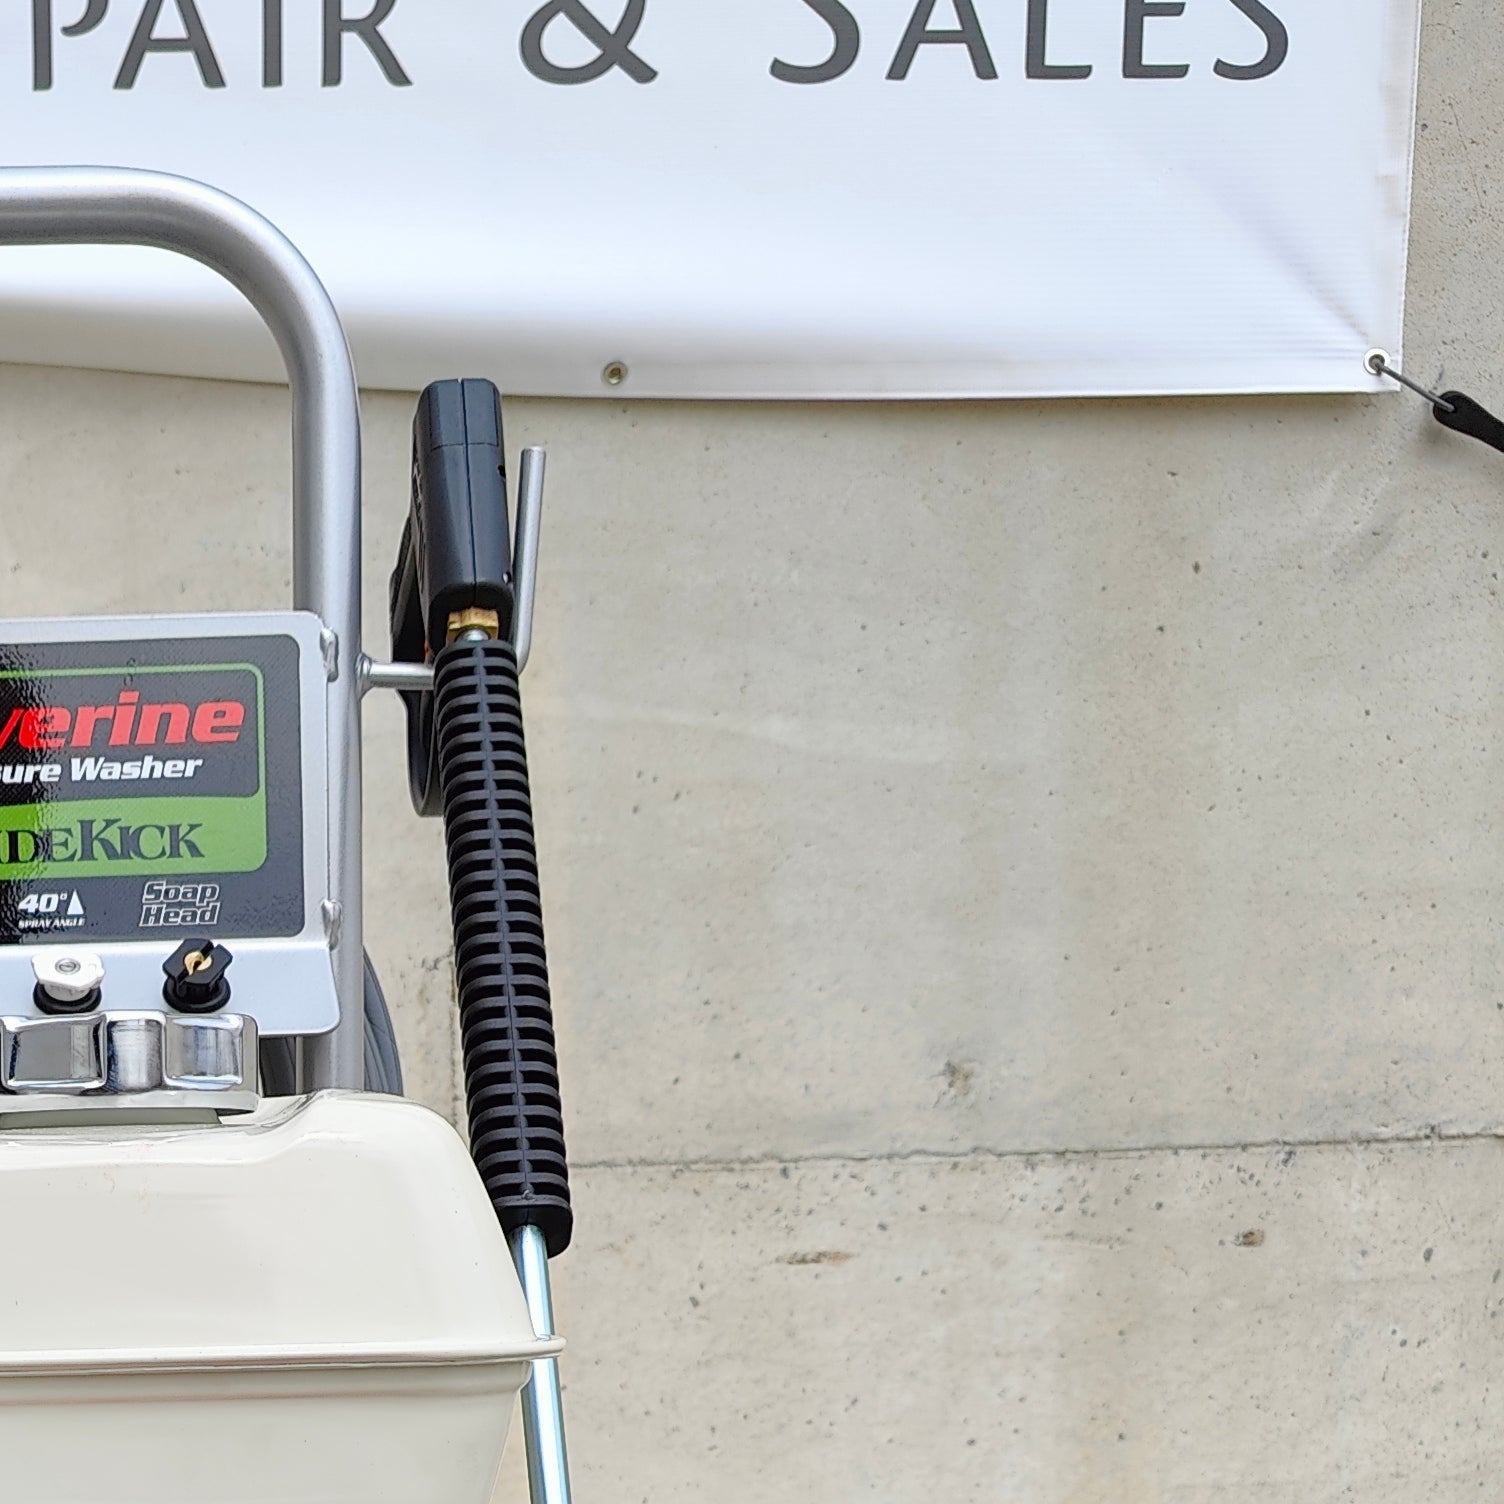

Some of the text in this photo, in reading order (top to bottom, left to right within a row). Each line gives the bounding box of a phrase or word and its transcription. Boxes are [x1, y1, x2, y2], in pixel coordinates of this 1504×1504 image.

[769, 0, 1290, 84] SALES
[71, 755, 202, 782] Washer
[143, 880, 219, 905] Soap
[18, 917, 85, 929] SPRAY ANGLE
[139, 902, 219, 928] Head
